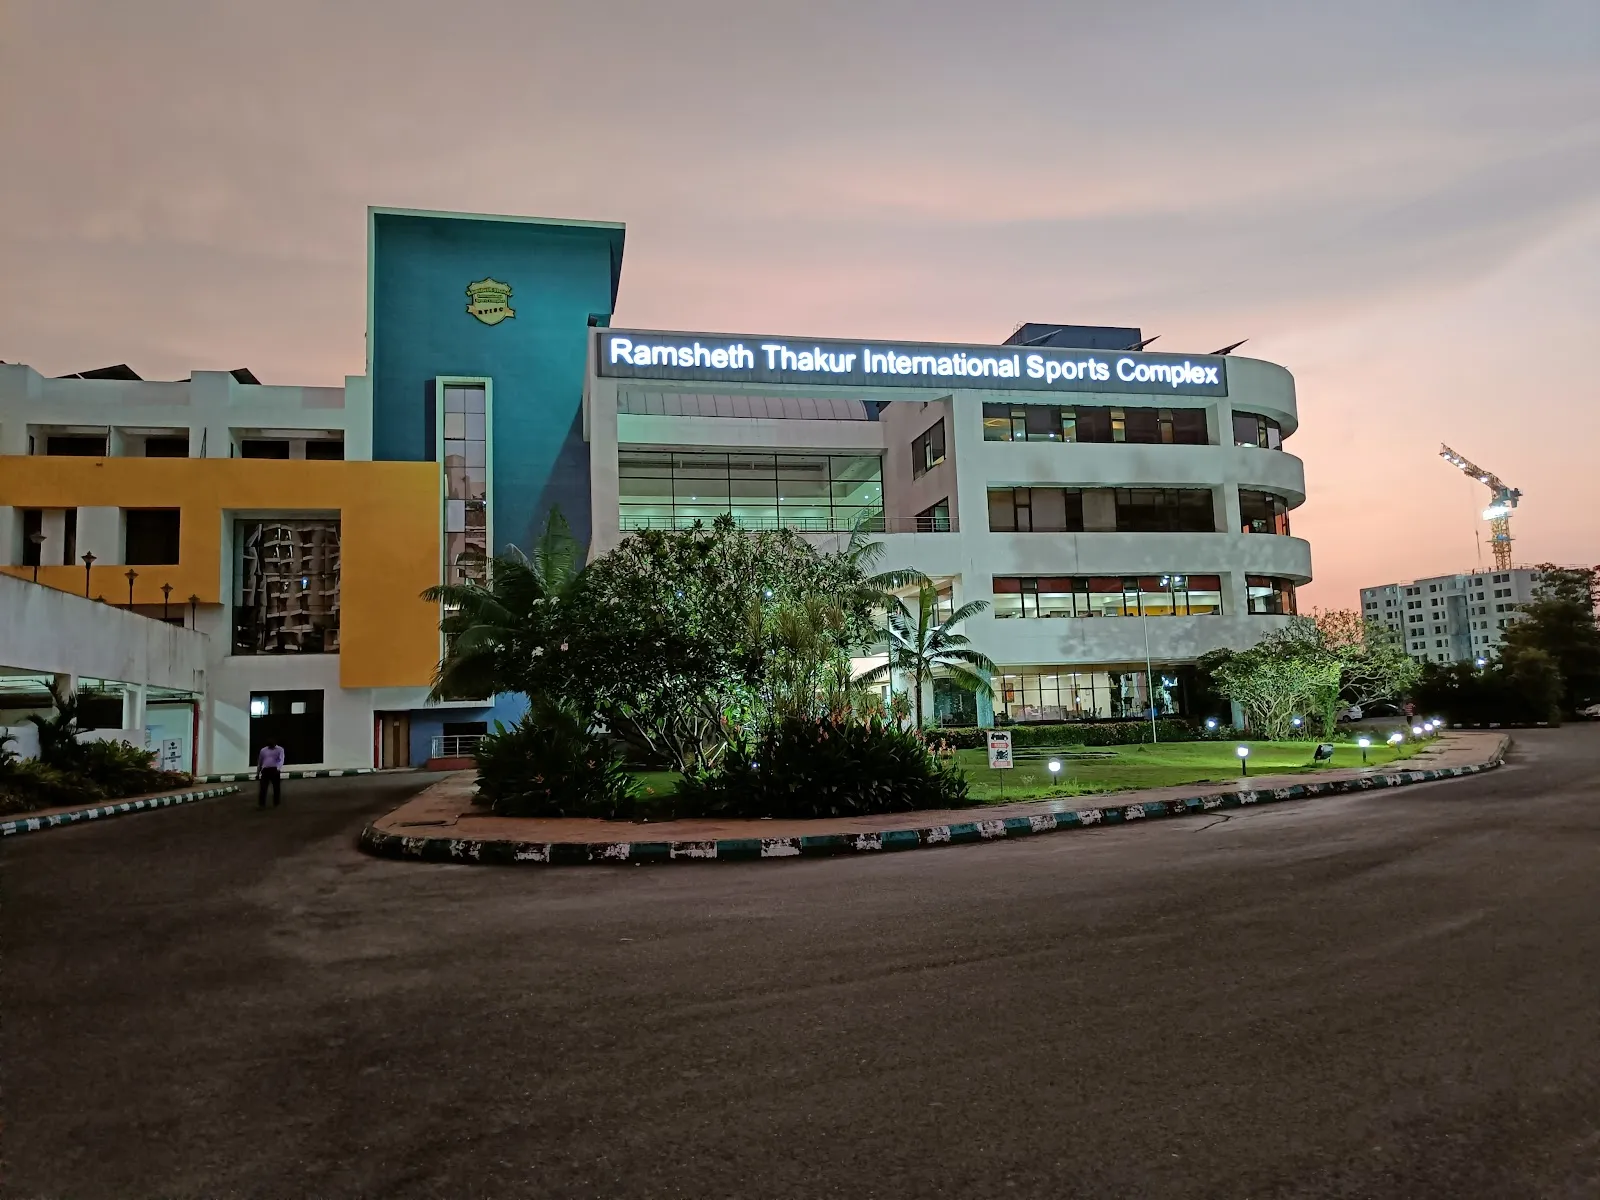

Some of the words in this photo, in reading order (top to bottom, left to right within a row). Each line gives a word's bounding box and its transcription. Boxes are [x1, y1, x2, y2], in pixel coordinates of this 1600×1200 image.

[610, 338, 754, 369] Ramsheth
[762, 344, 857, 373] Thakur
[864, 348, 1020, 378] International
[1026, 354, 1110, 384] Sports
[1116, 358, 1219, 388] Complex
